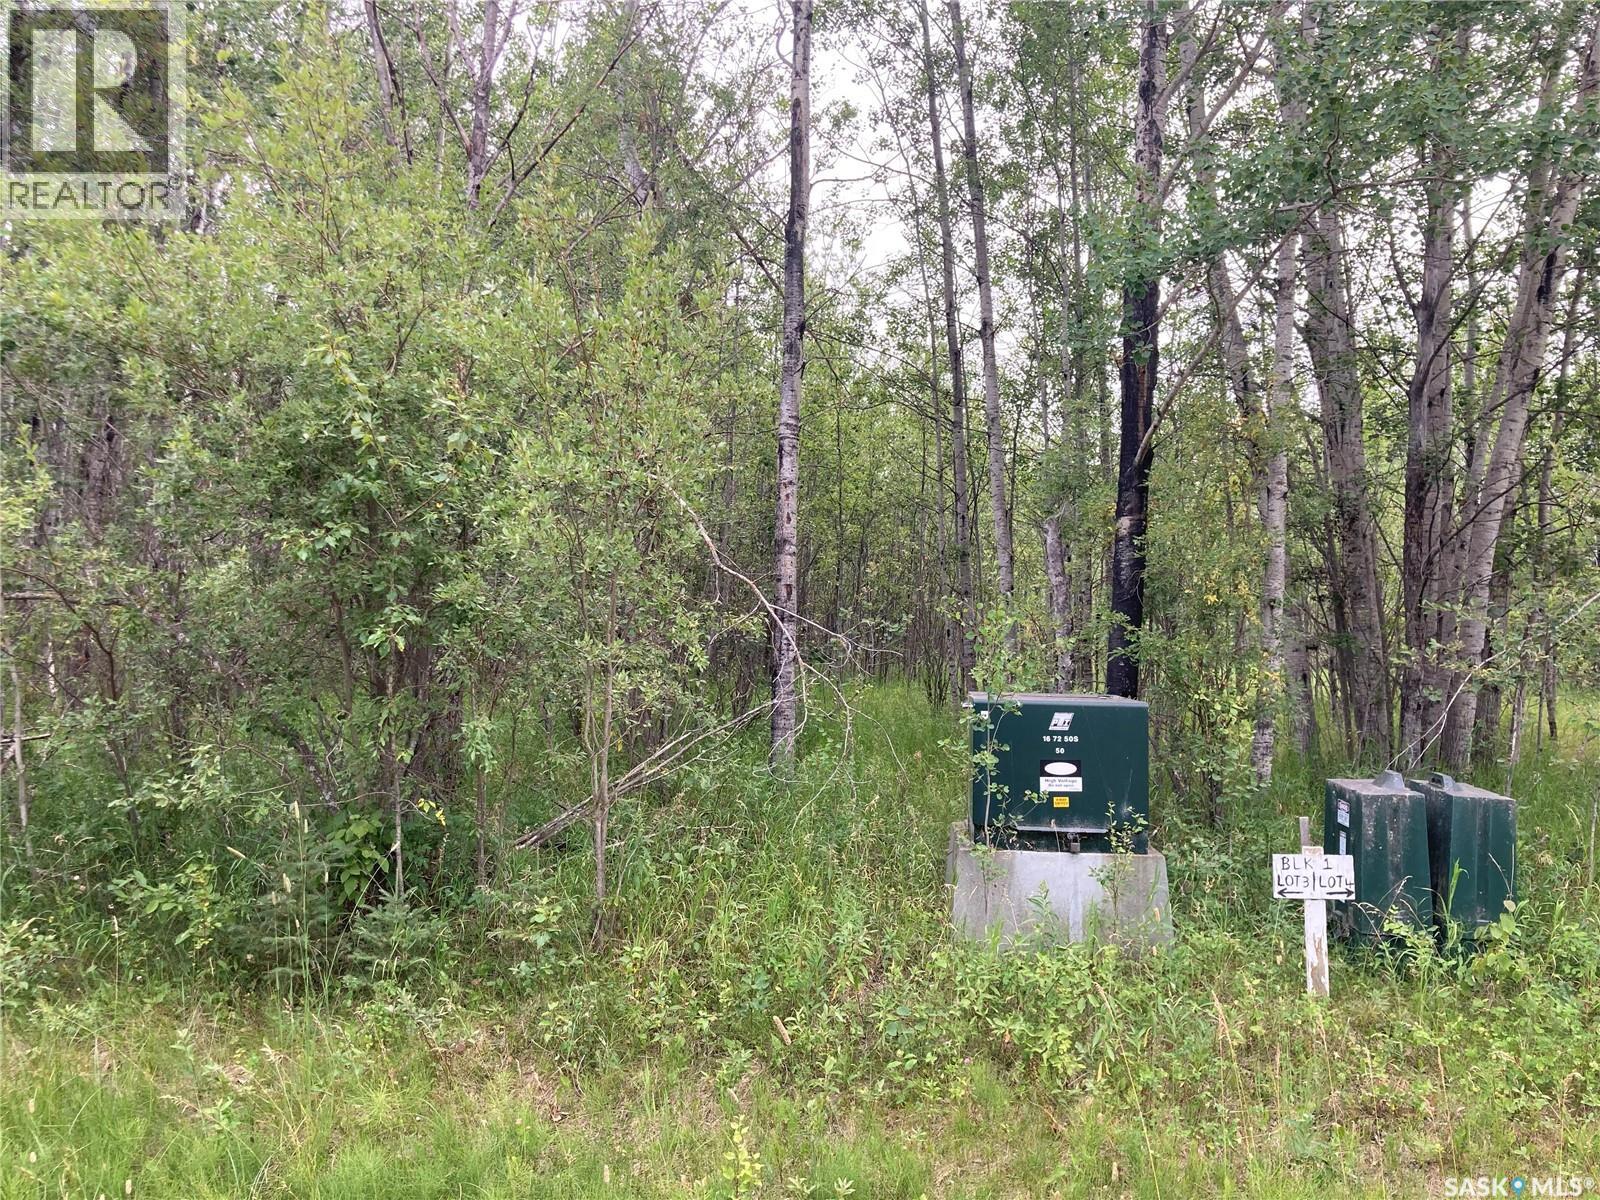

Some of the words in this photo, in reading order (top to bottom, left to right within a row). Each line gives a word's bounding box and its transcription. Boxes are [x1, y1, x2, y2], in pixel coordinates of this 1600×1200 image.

[1063, 735, 1079, 743] 50S
[1281, 856, 1313, 871] BLK
[1323, 858, 1333, 870] 1
